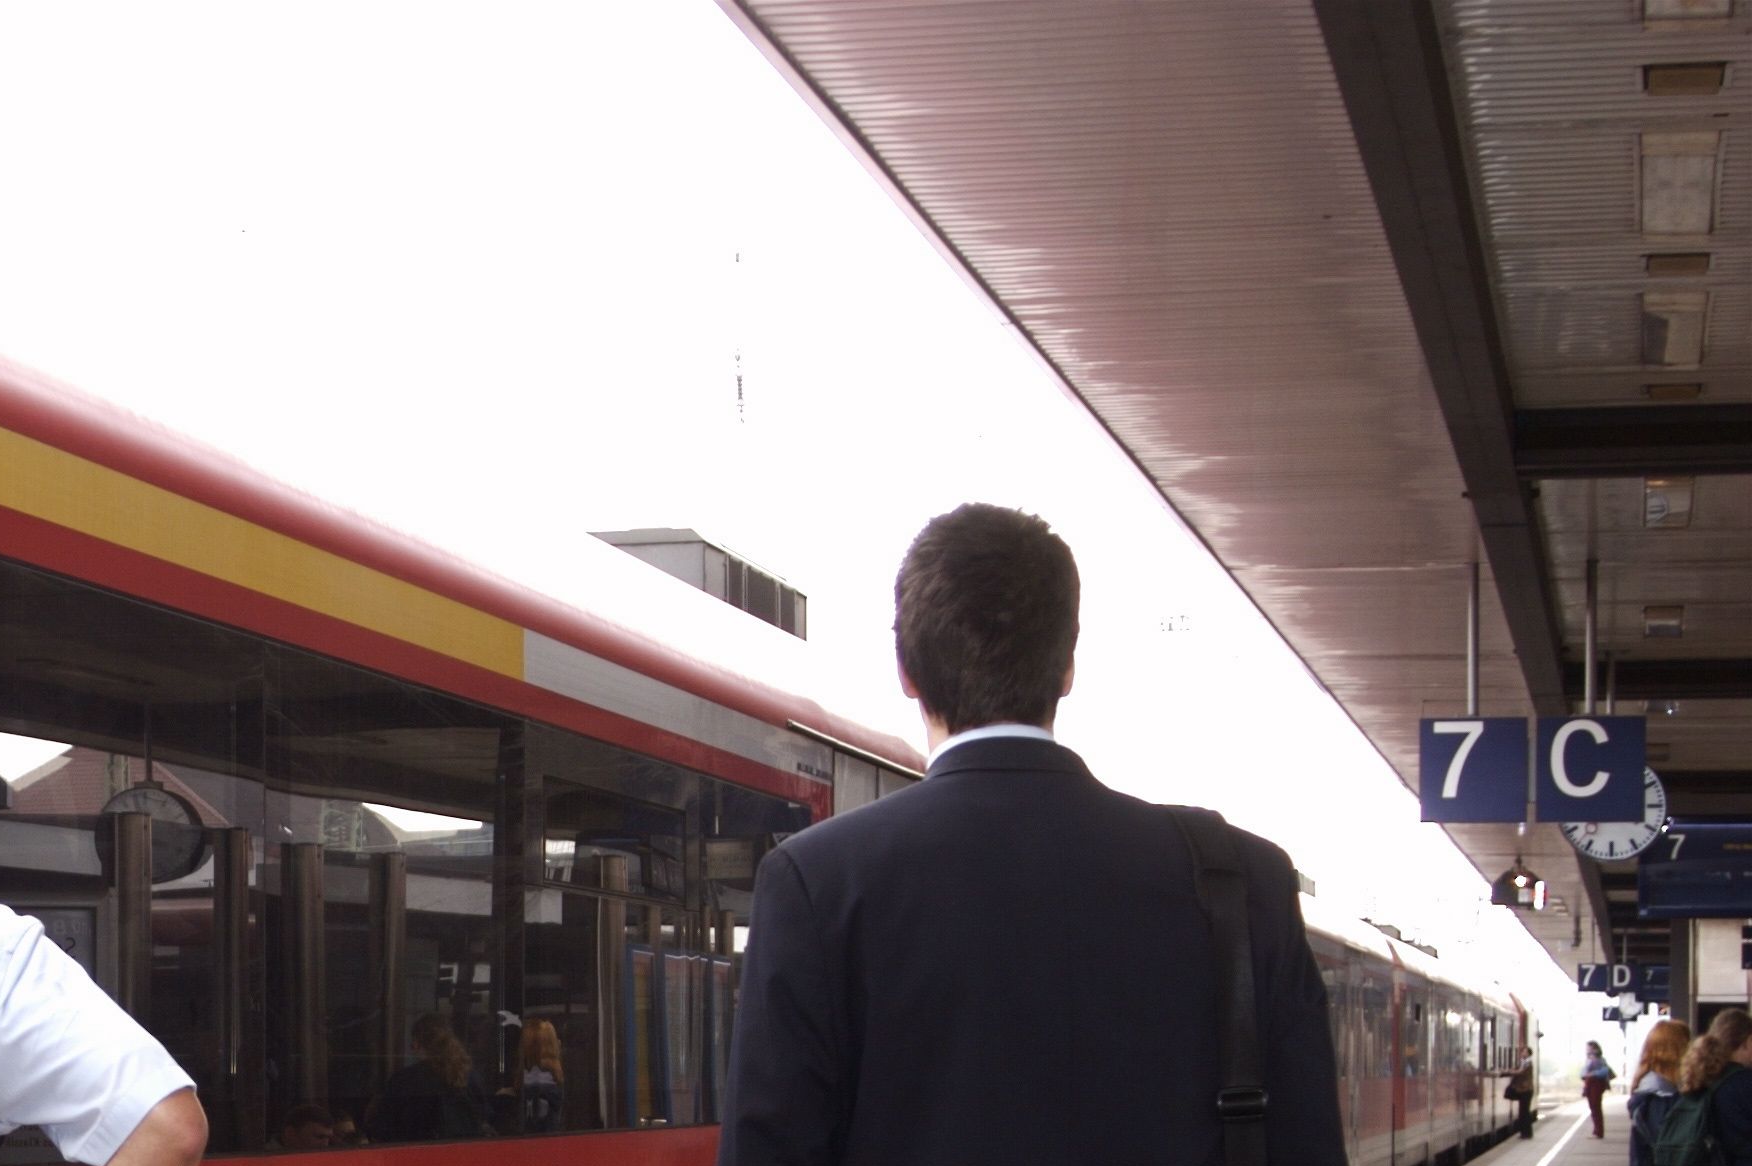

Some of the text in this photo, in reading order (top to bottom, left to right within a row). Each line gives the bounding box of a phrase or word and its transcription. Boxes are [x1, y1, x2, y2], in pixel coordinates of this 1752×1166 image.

[1432, 719, 1610, 798] 7 C
[1667, 834, 1686, 860] 7
[1581, 964, 1631, 987] 7 D
